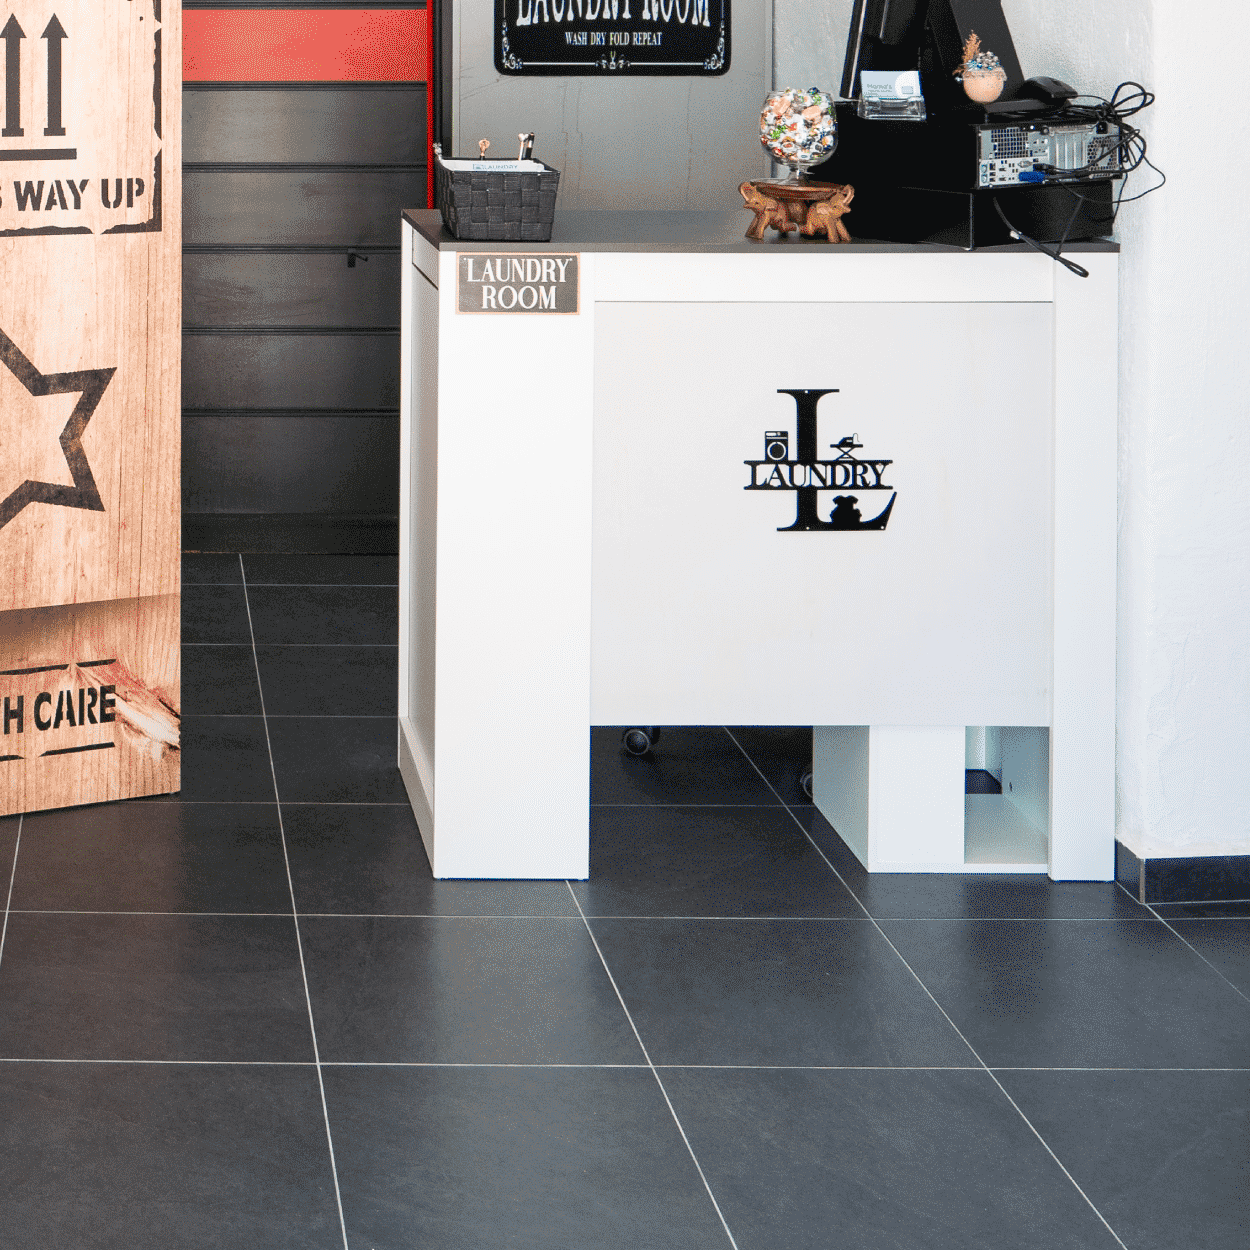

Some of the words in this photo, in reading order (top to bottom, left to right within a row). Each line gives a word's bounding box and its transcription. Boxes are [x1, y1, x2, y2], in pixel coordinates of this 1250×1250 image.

[565, 32, 588, 46] WASH
[590, 32, 607, 46] DRY
[610, 32, 630, 46] FOLD
[632, 32, 662, 46] REPEAT
[14, 179, 90, 212] WAY
[100, 178, 145, 209] UP
[467, 258, 570, 283] LAUNDRY
[482, 286, 557, 310] ROOM
[744, 460, 894, 490] LAUNDRY
[776, 388, 897, 532] L
[33, 685, 116, 732] CARE
